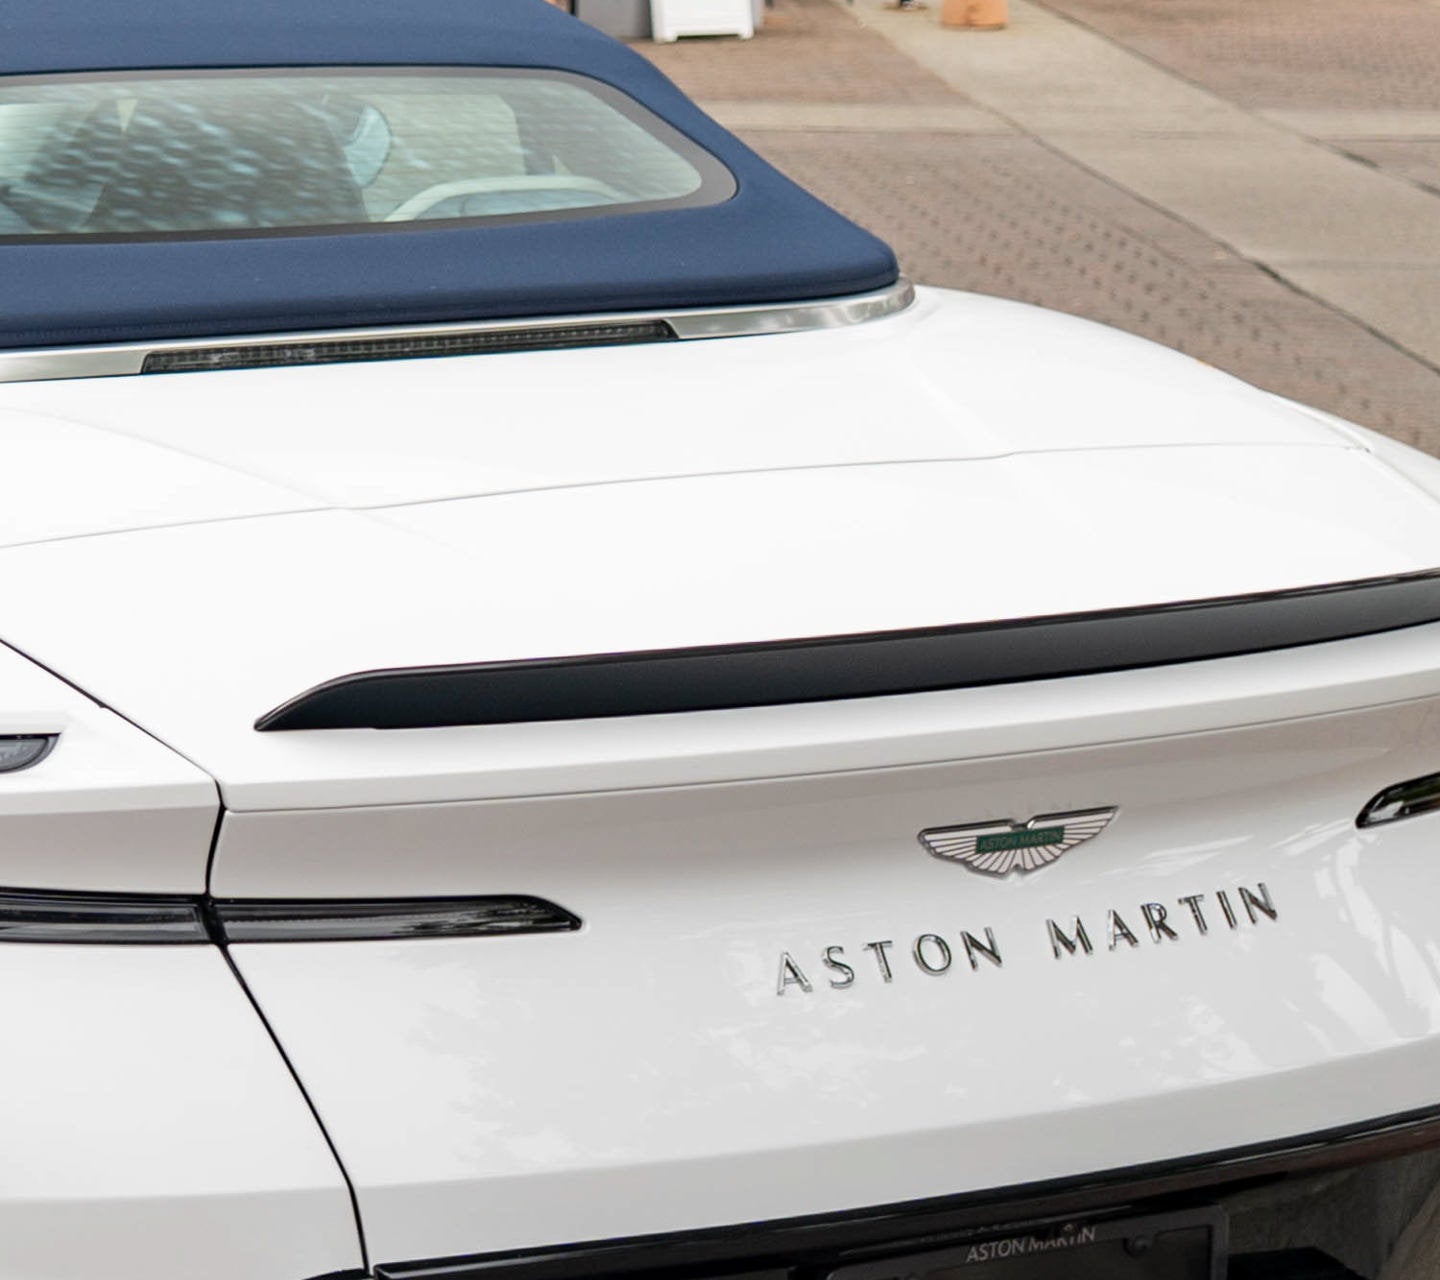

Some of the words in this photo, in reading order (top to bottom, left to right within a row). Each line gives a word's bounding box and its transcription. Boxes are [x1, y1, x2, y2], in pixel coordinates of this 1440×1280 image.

[980, 835, 1017, 852] ASTON
[1020, 828, 1062, 846] MARTIN
[776, 926, 1004, 996] ASTON
[1046, 882, 1278, 960] MARTIN
[966, 1236, 1024, 1263] ASTON
